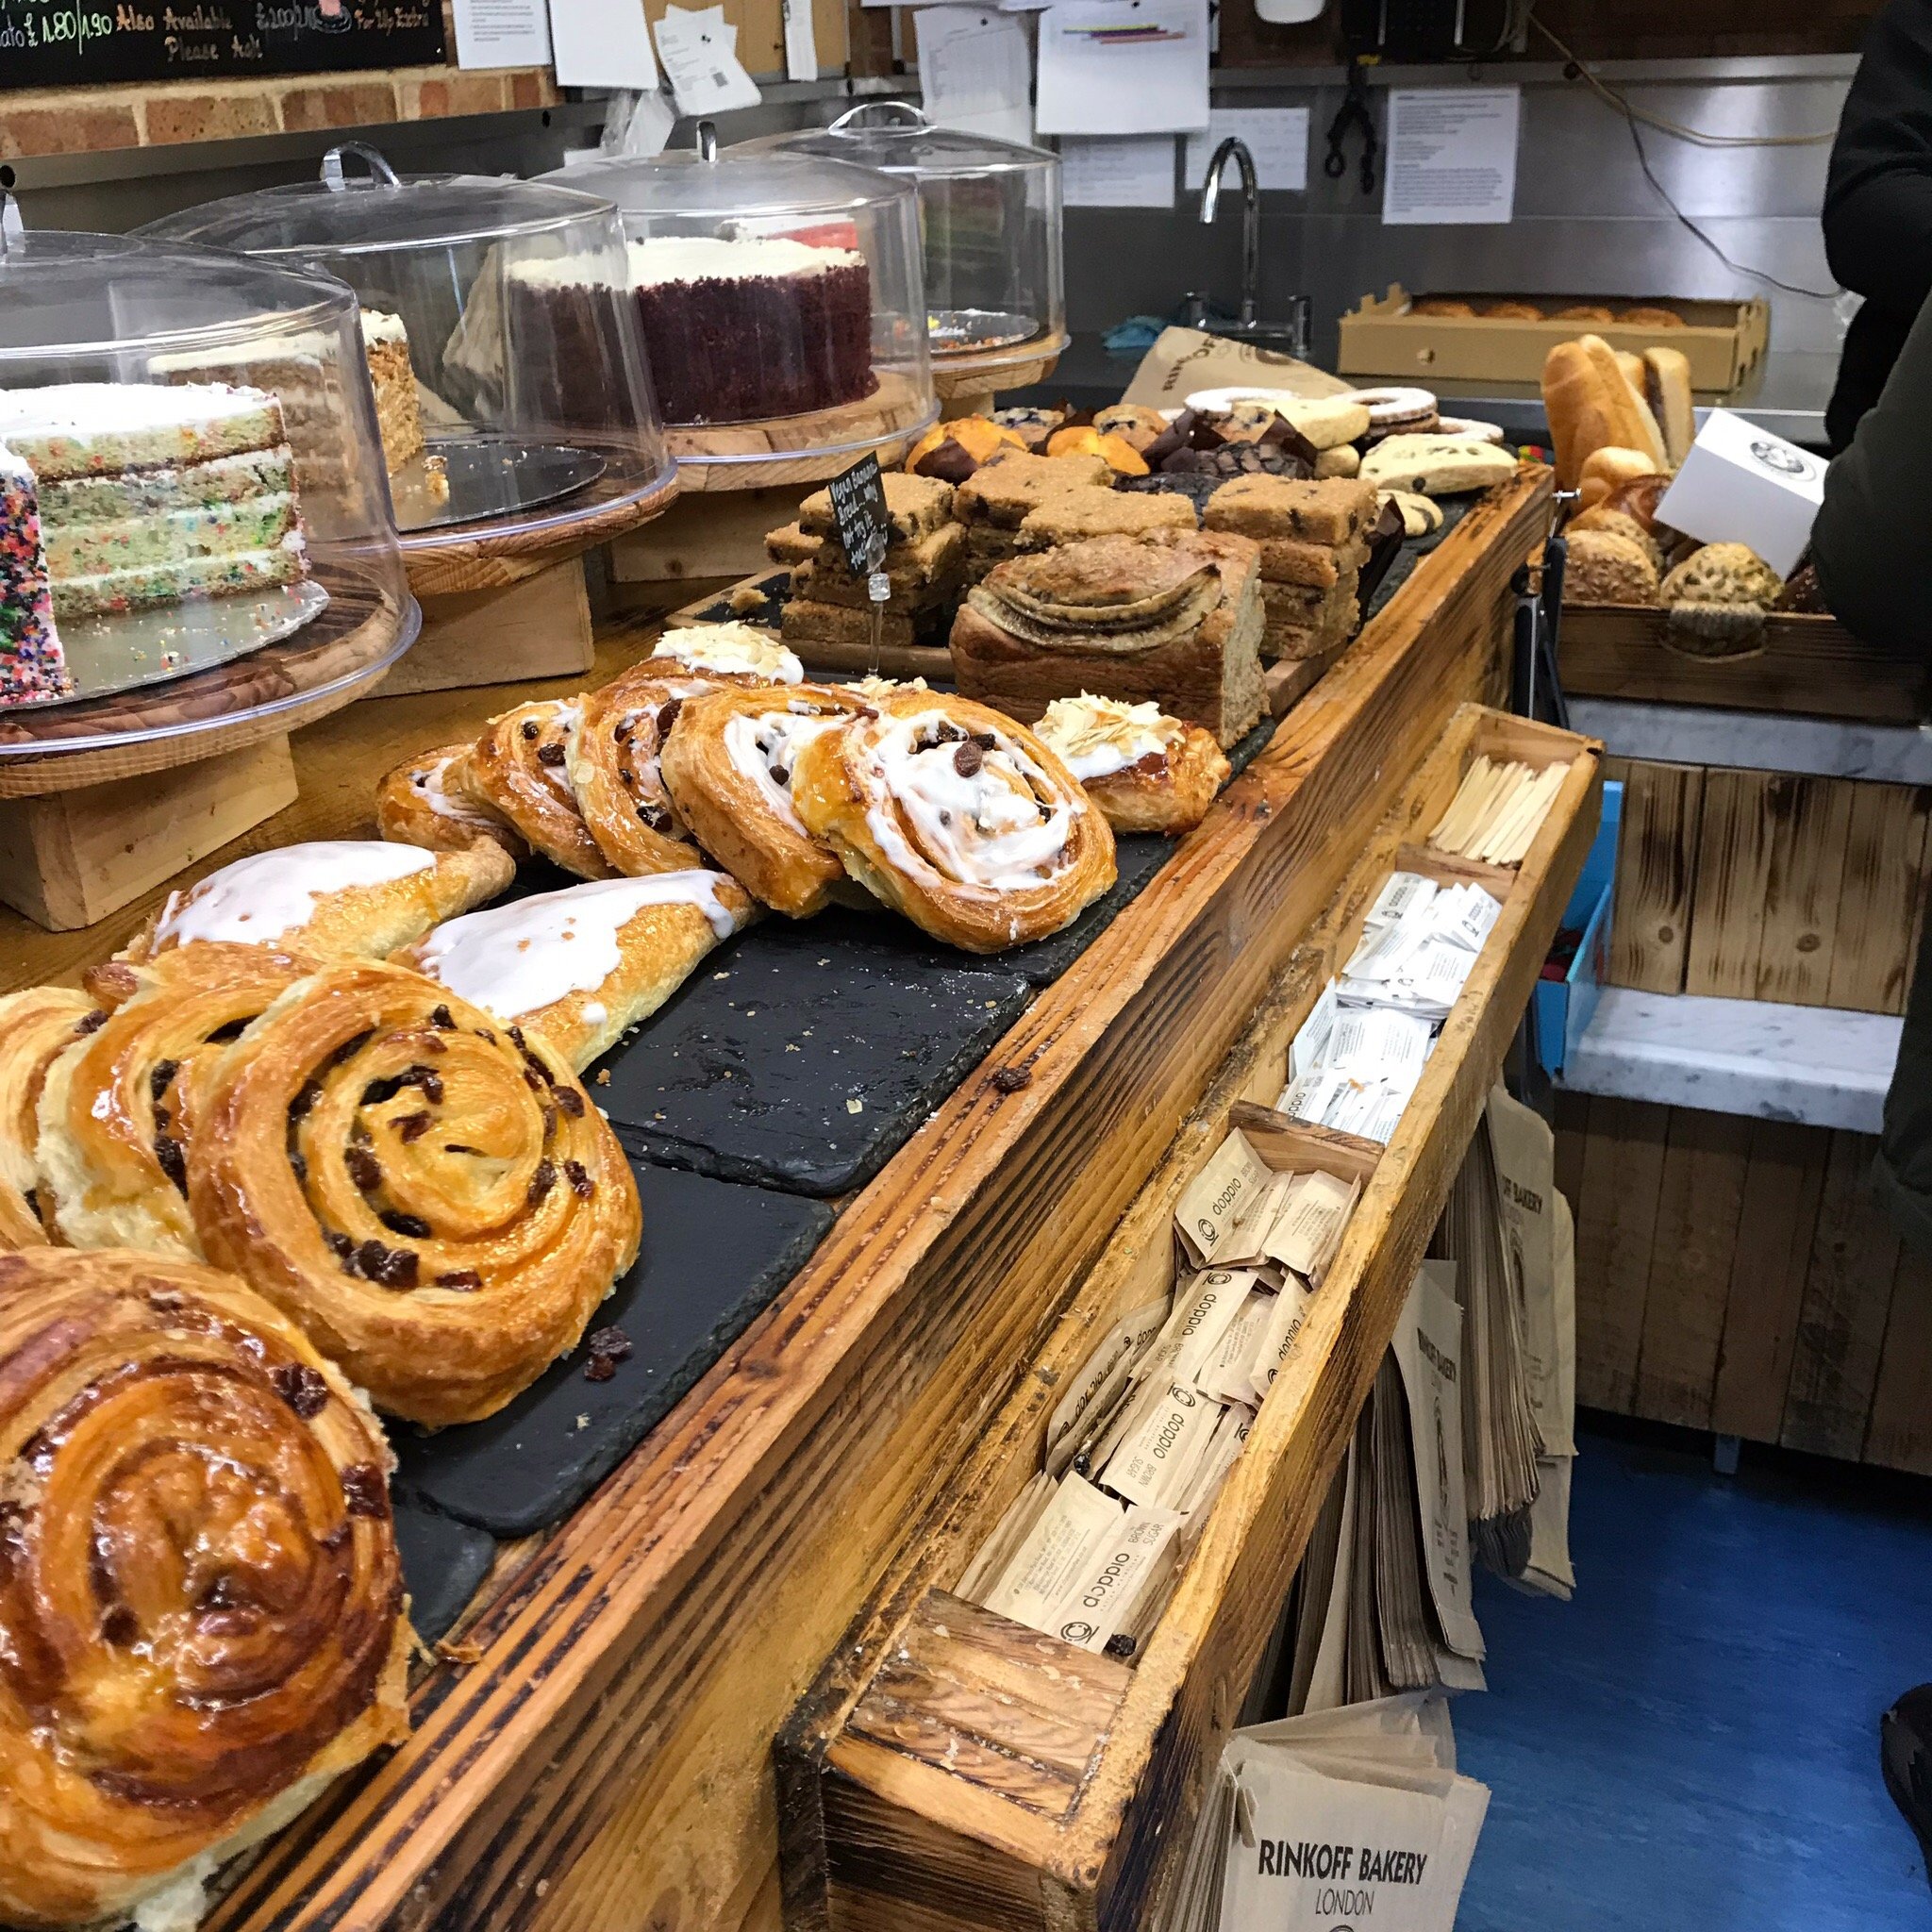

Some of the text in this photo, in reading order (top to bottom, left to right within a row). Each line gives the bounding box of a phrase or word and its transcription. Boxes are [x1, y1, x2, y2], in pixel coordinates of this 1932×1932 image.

[115, 4, 155, 31] Also
[163, 35, 219, 62] Please
[1288, 1091, 1306, 1119] oppio
[1212, 1177, 1241, 1216] doppio
[1182, 1292, 1217, 1336] doppio
[1153, 1412, 1185, 1459] doppio
[1126, 1457, 1143, 1478] SUGAR
[1140, 1463, 1157, 1488] BROWN
[1127, 1522, 1151, 1544] BROWN
[1143, 1524, 1164, 1546] SUGAR
[1258, 1840, 1428, 1886] RINKOFF BAKERY
[1315, 1888, 1374, 1917] LONDON
